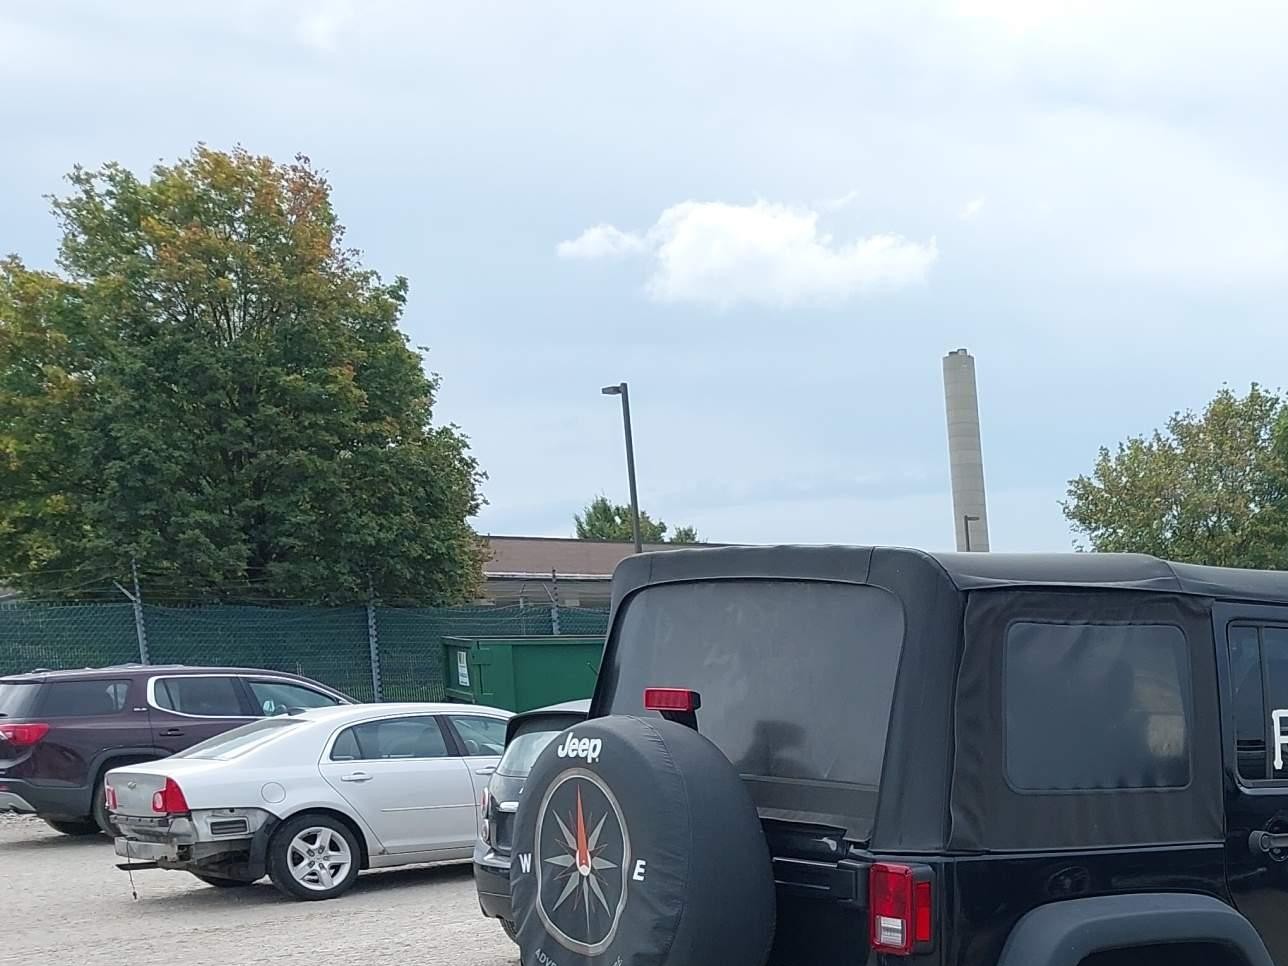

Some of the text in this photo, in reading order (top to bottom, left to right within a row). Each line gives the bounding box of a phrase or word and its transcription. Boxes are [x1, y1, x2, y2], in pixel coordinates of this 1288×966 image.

[557, 732, 603, 763] Jeep
[518, 852, 532, 874] W
[632, 859, 647, 881] E
